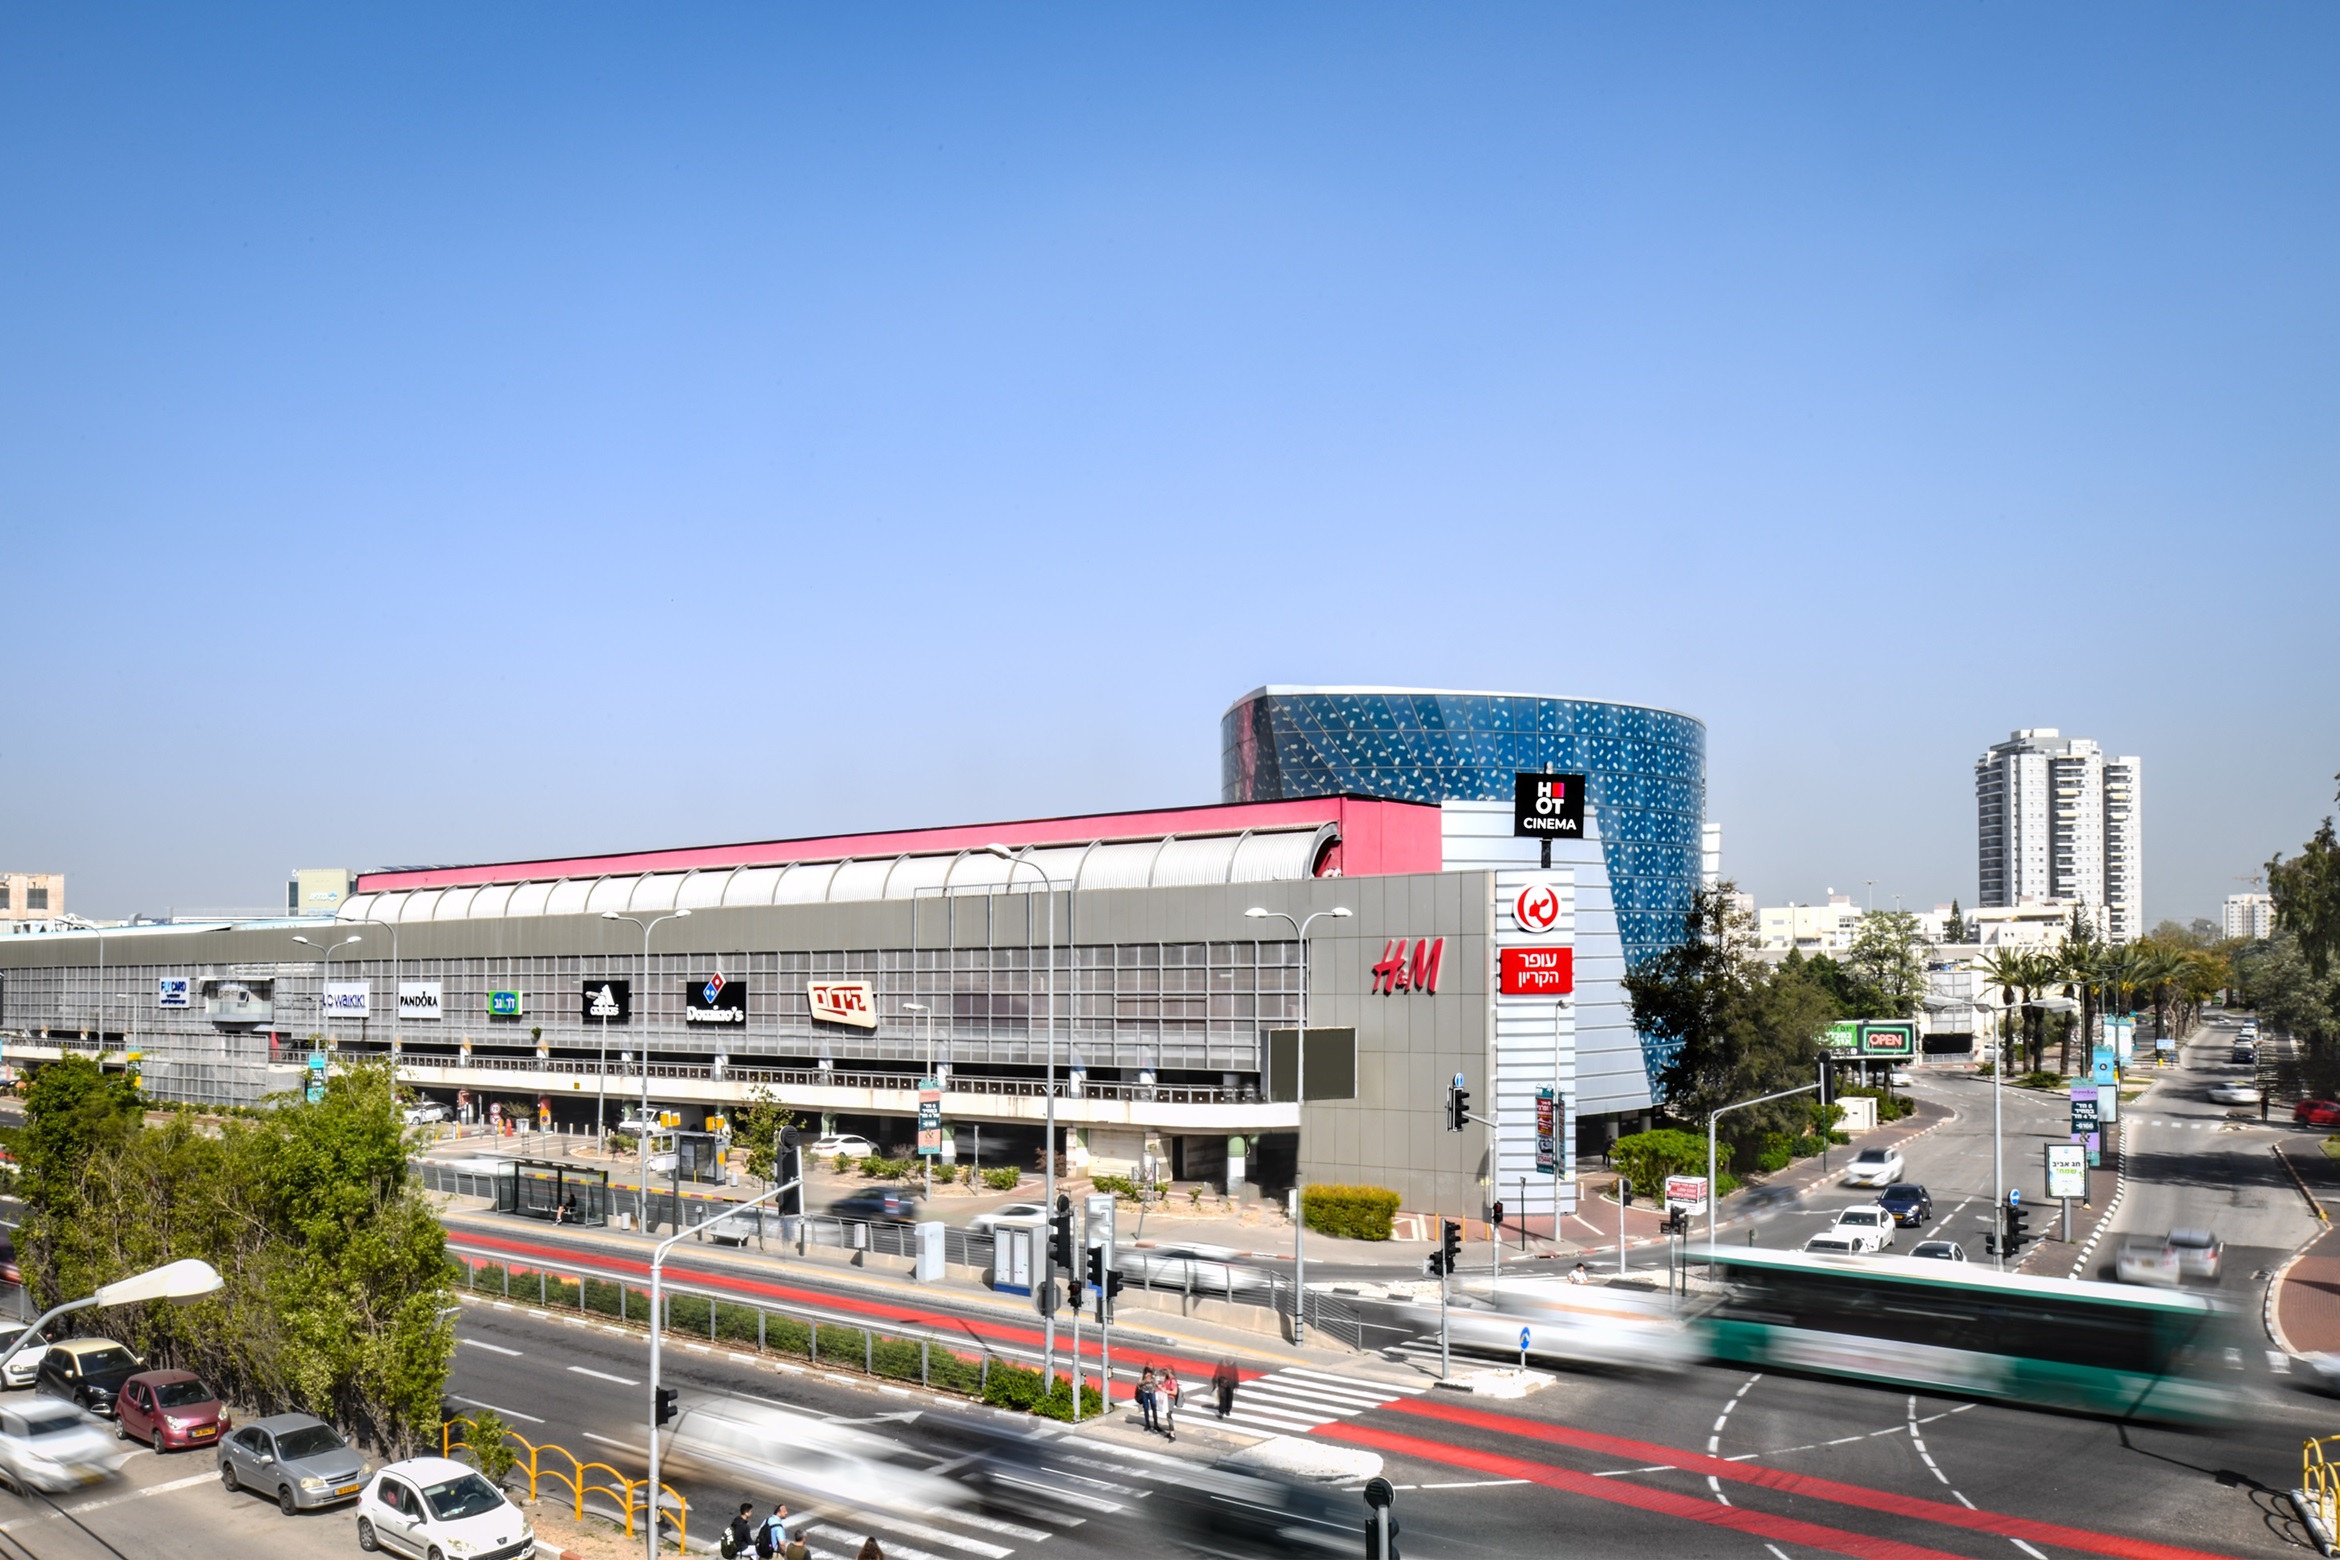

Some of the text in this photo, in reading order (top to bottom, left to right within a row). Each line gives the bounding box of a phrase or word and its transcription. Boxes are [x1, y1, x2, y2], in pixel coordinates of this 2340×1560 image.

[1523, 817, 1577, 831] CINEMA
[1373, 938, 1444, 995] H&M
[1518, 953, 1558, 968] עופר
[1518, 970, 1559, 988] הקריון
[400, 992, 438, 1007] PANDORA
[686, 1005, 744, 1022] Domino's
[1869, 1034, 1902, 1046] OPEN
